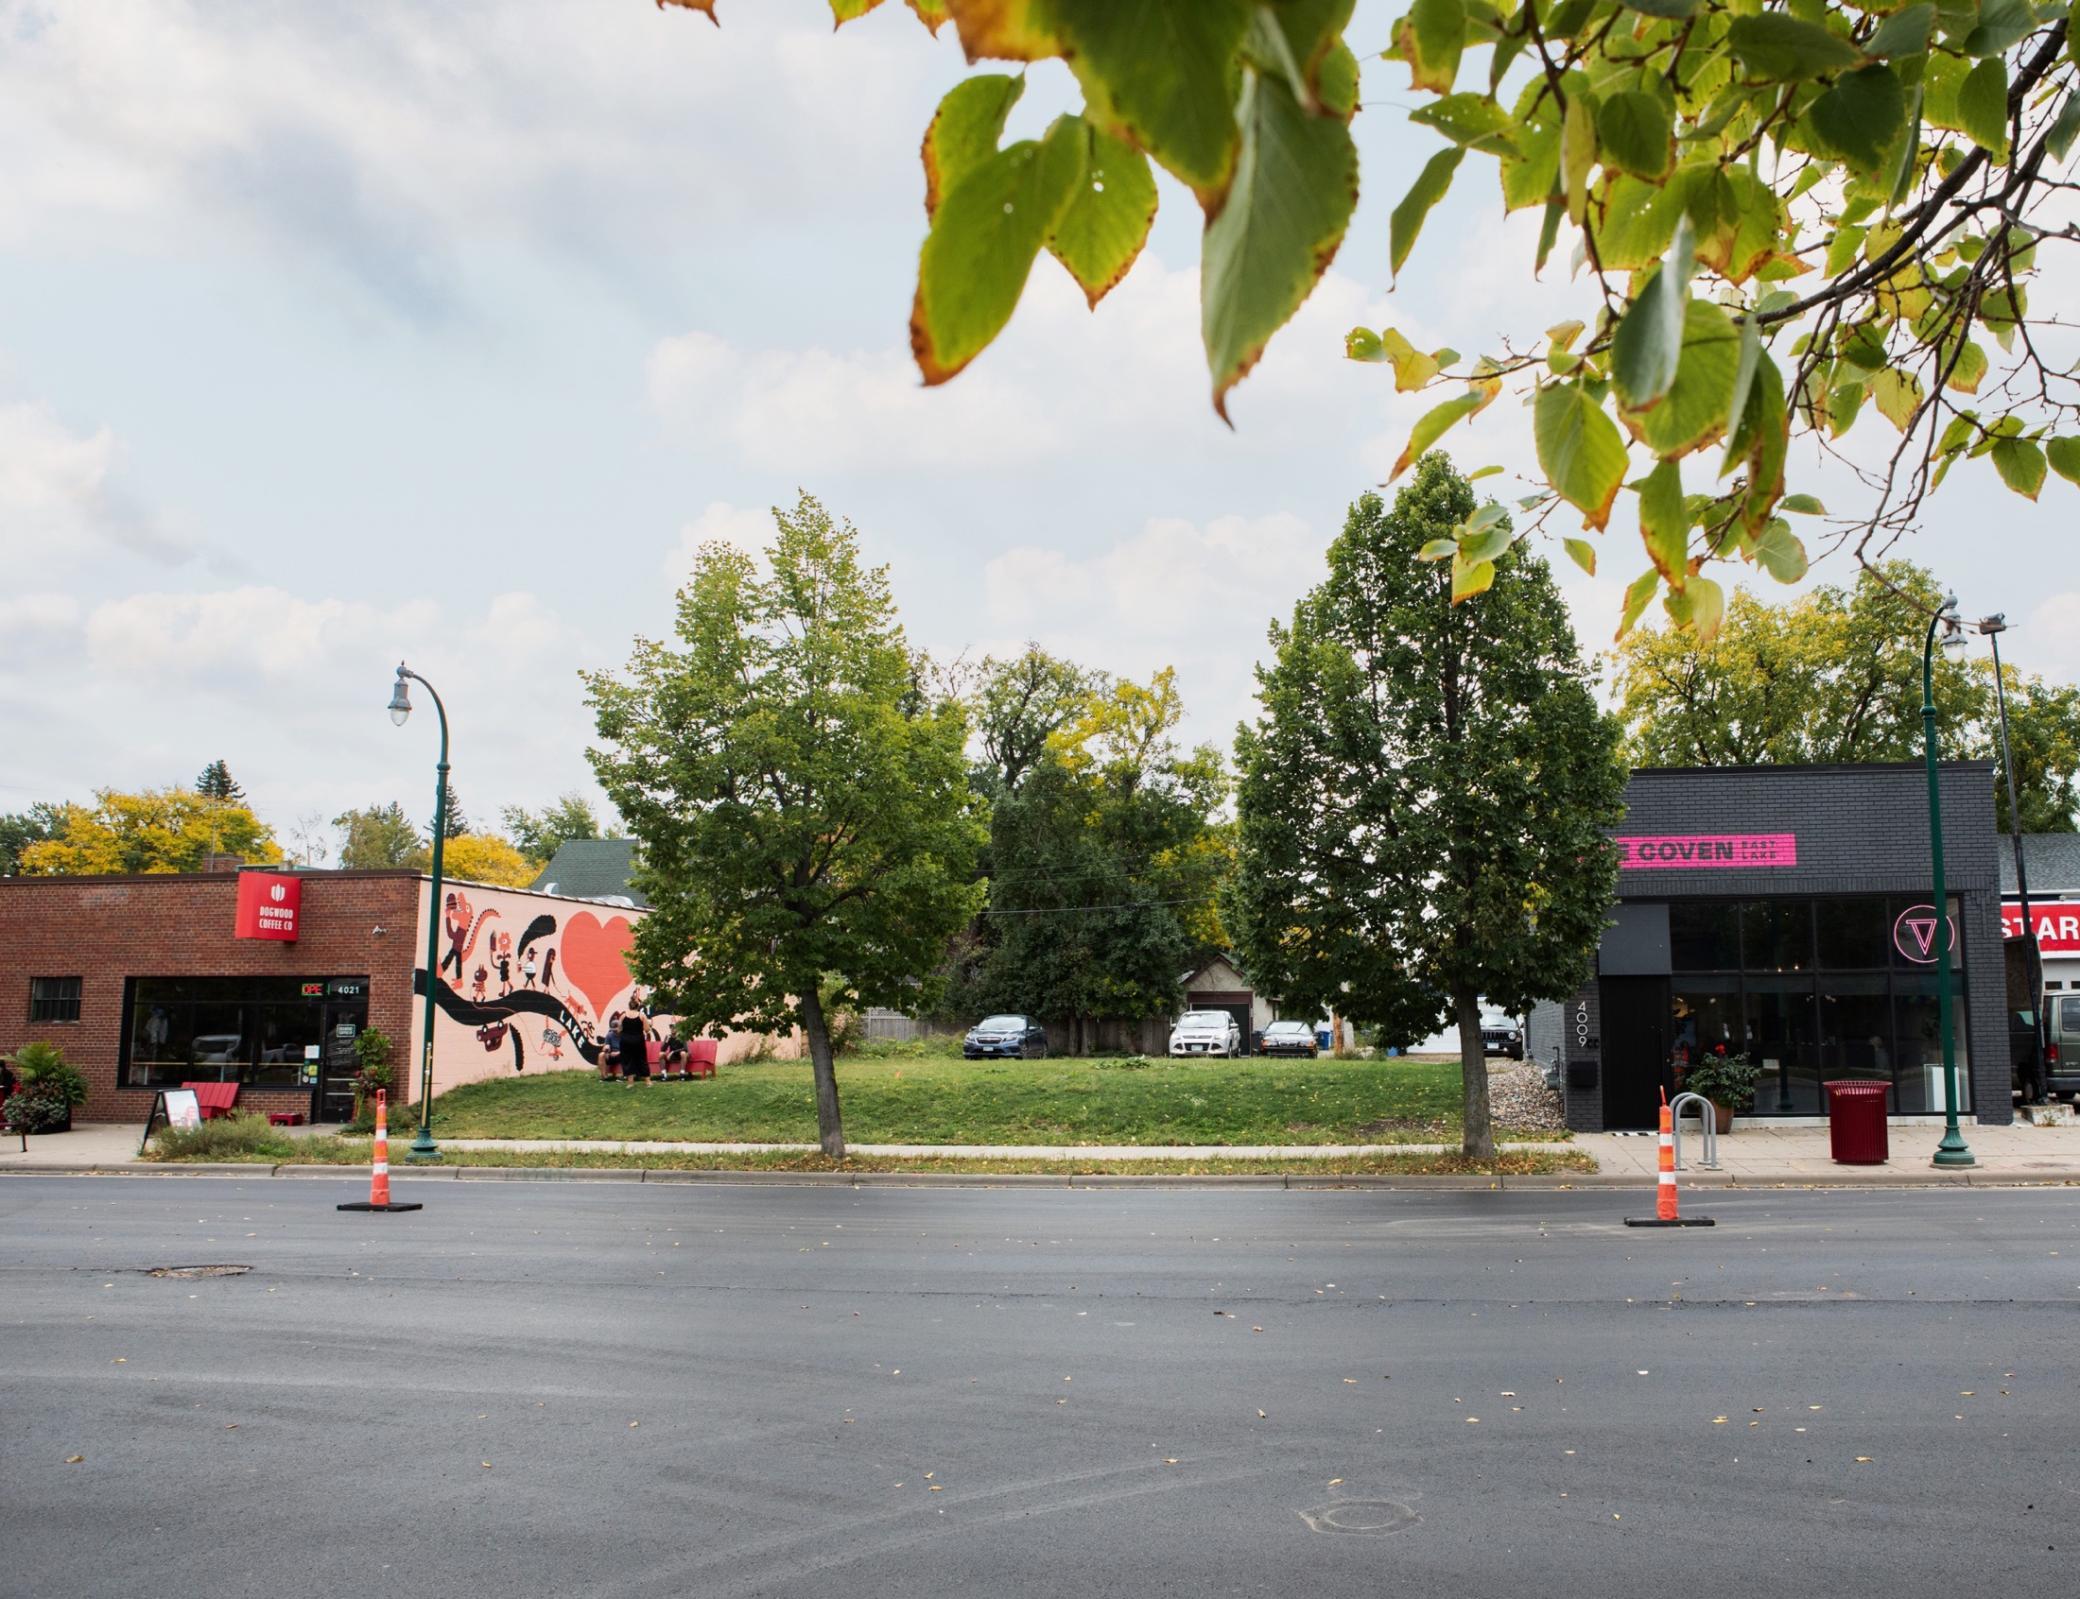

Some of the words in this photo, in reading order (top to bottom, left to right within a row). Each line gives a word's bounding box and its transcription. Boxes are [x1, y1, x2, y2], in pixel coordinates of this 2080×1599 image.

[1638, 841, 1734, 861] COVEN
[1742, 840, 1777, 849] EAST
[1742, 851, 1777, 860] LAKE
[260, 905, 294, 919] DOGWOOD
[259, 918, 282, 930] COFFEE
[284, 920, 293, 931] CO
[338, 986, 360, 995] 4021
[560, 1009, 585, 1049] LAKE
[1576, 1000, 1588, 1047] 4009
